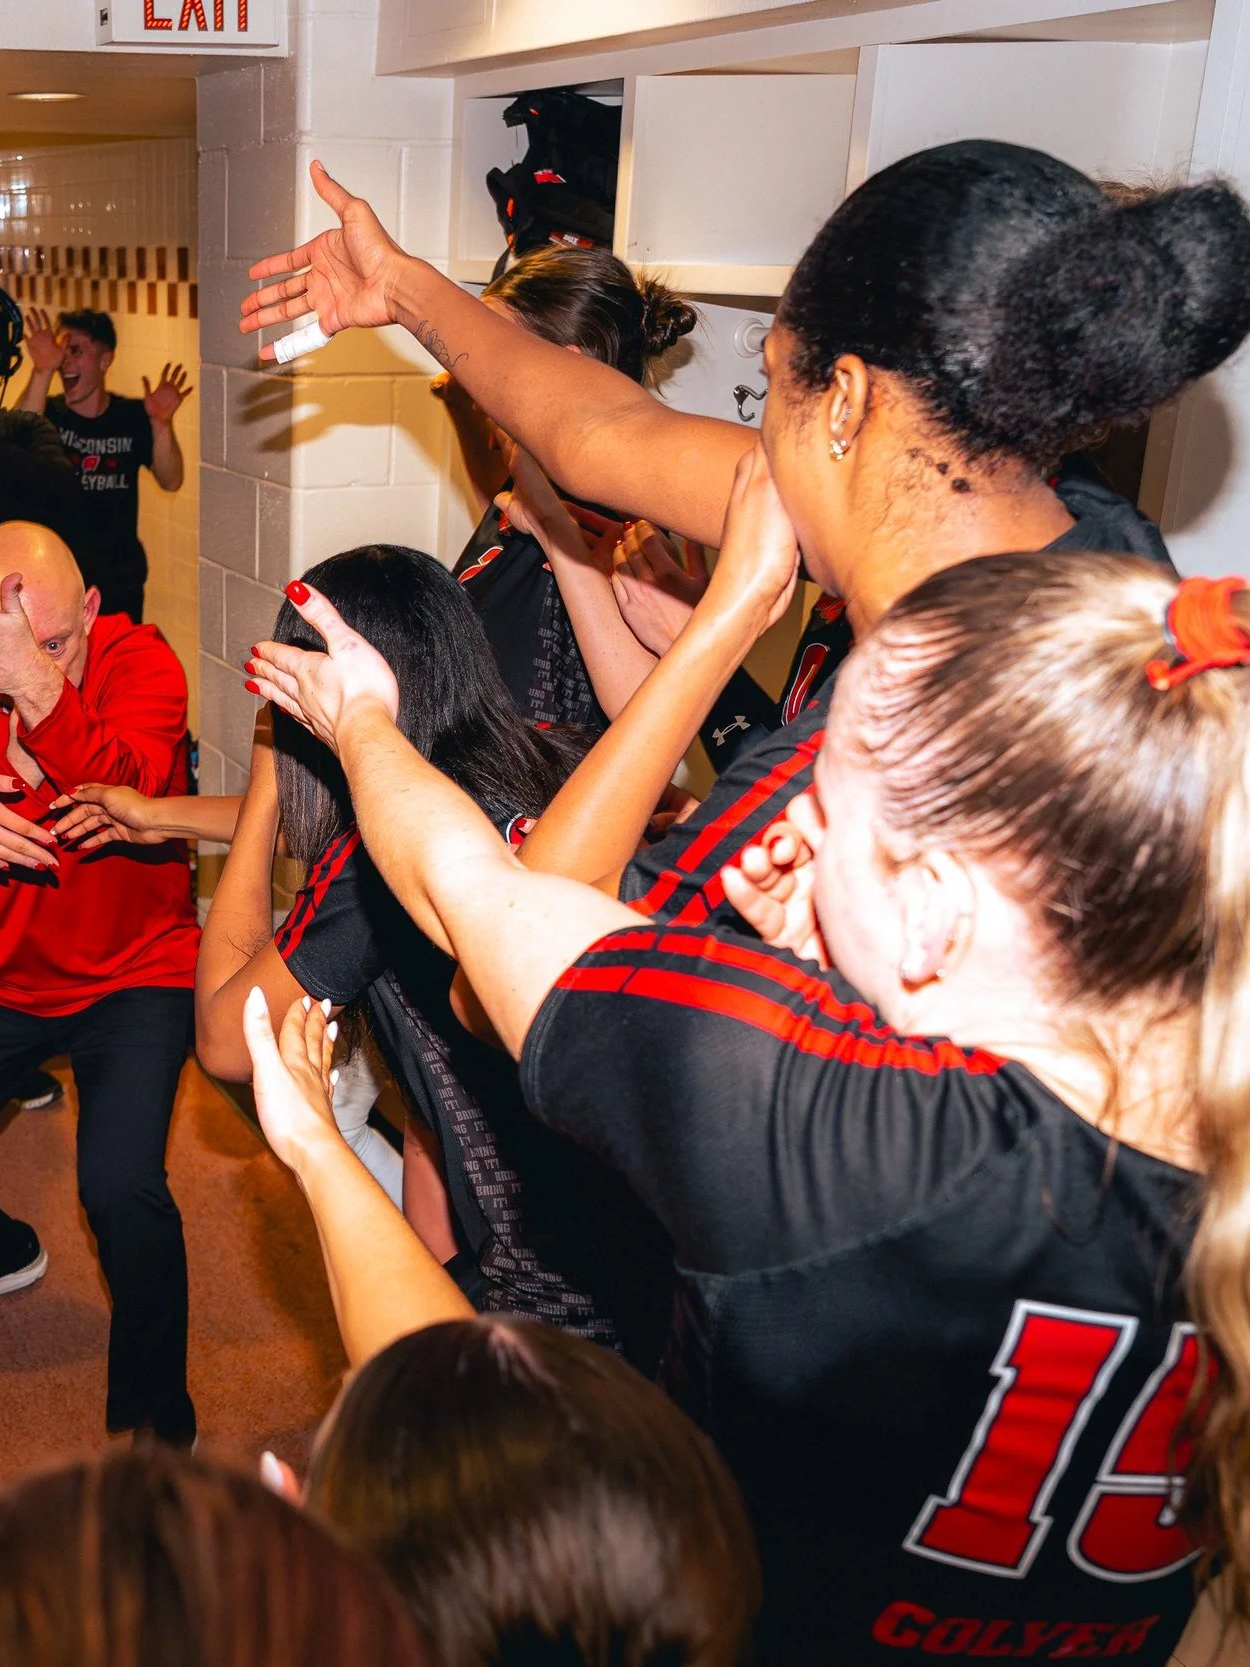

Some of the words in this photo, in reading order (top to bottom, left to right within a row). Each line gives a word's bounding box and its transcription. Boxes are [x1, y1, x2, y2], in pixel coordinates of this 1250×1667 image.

[430, 1063, 447, 1075] IT!
[438, 1087, 455, 1099] ING
[445, 1099, 461, 1111] IT!
[484, 1158, 500, 1170] IT!
[475, 1183, 505, 1197] BRING
[492, 1197, 508, 1209] IT!
[491, 1222, 511, 1234] ING
[520, 1260, 538, 1271] IT!
[535, 1302, 569, 1316] BRING
